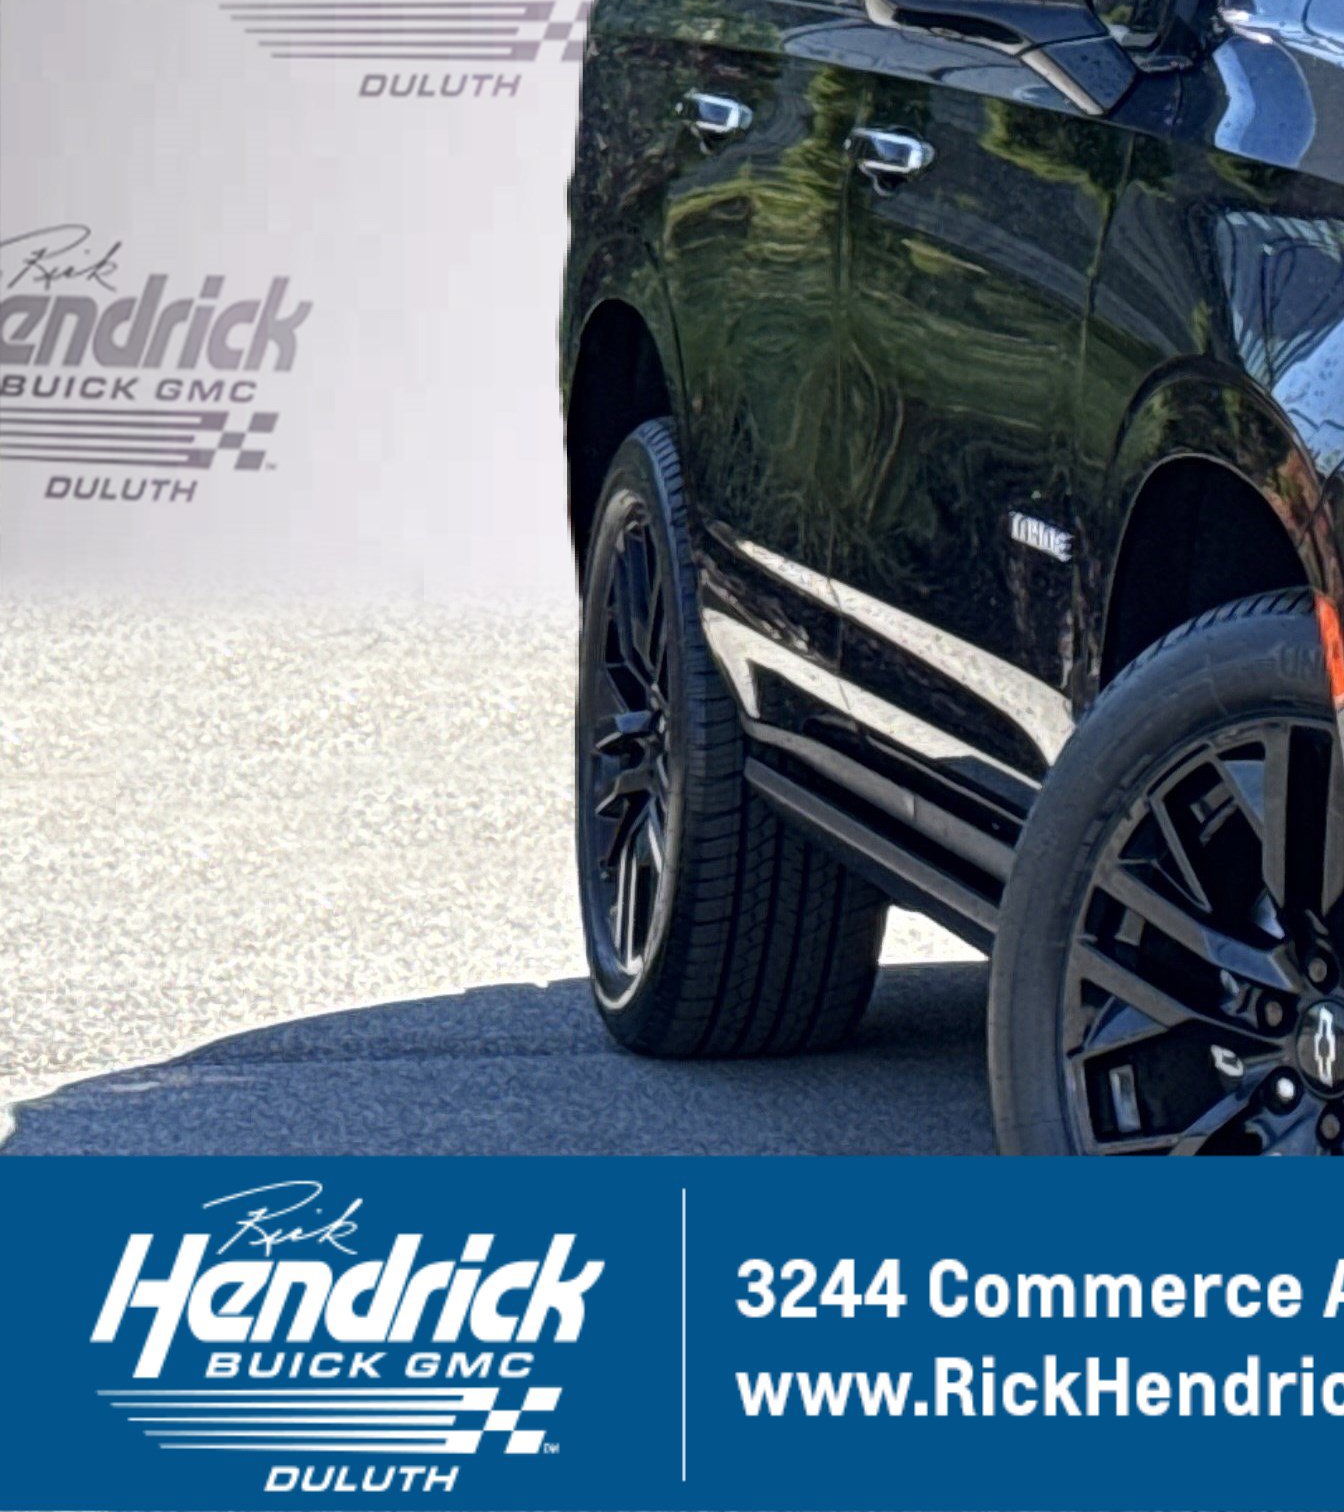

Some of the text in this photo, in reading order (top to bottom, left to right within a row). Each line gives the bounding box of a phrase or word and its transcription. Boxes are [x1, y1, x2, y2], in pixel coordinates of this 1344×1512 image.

[358, 73, 522, 98] DULUTH
[1, 374, 257, 403] BUICK GMC
[44, 475, 198, 503] DULUTH
